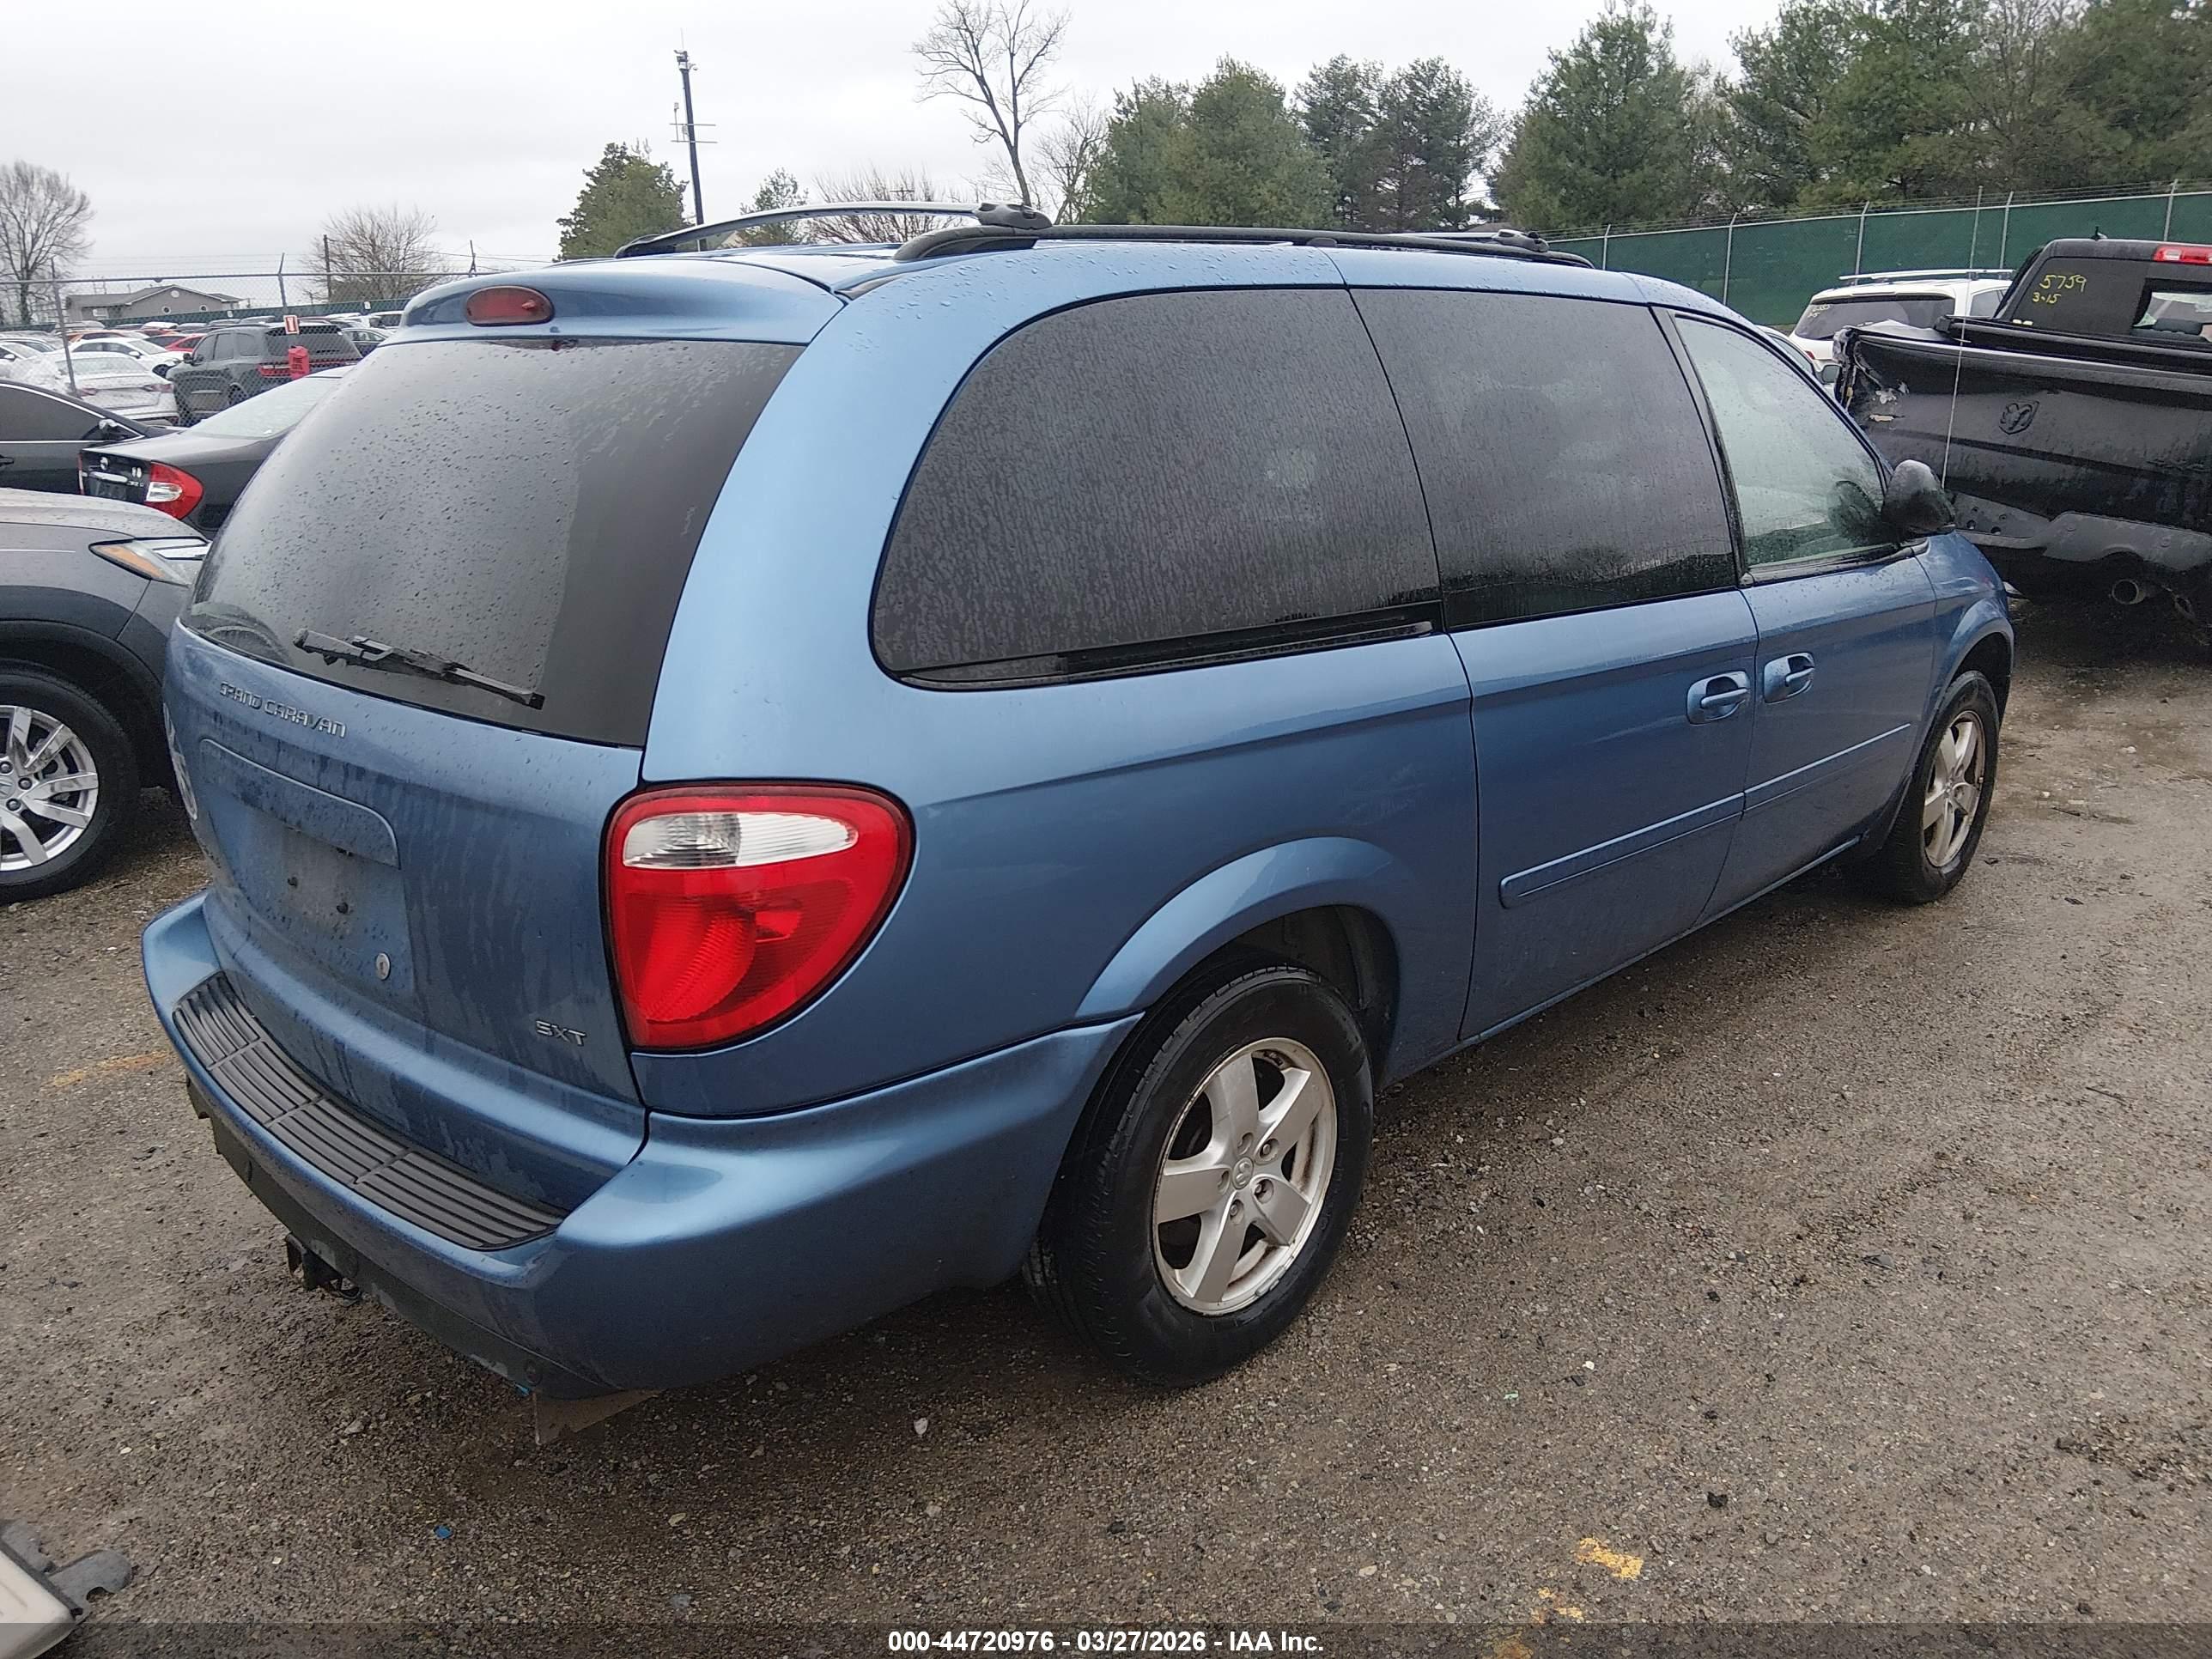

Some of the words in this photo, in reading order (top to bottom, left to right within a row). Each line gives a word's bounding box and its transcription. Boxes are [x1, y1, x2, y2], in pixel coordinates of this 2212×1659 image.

[2039, 274, 2087, 293] 5759
[219, 681, 263, 710] GRAND
[264, 699, 347, 738] CARAVAN
[535, 1019, 586, 1046] SXT
